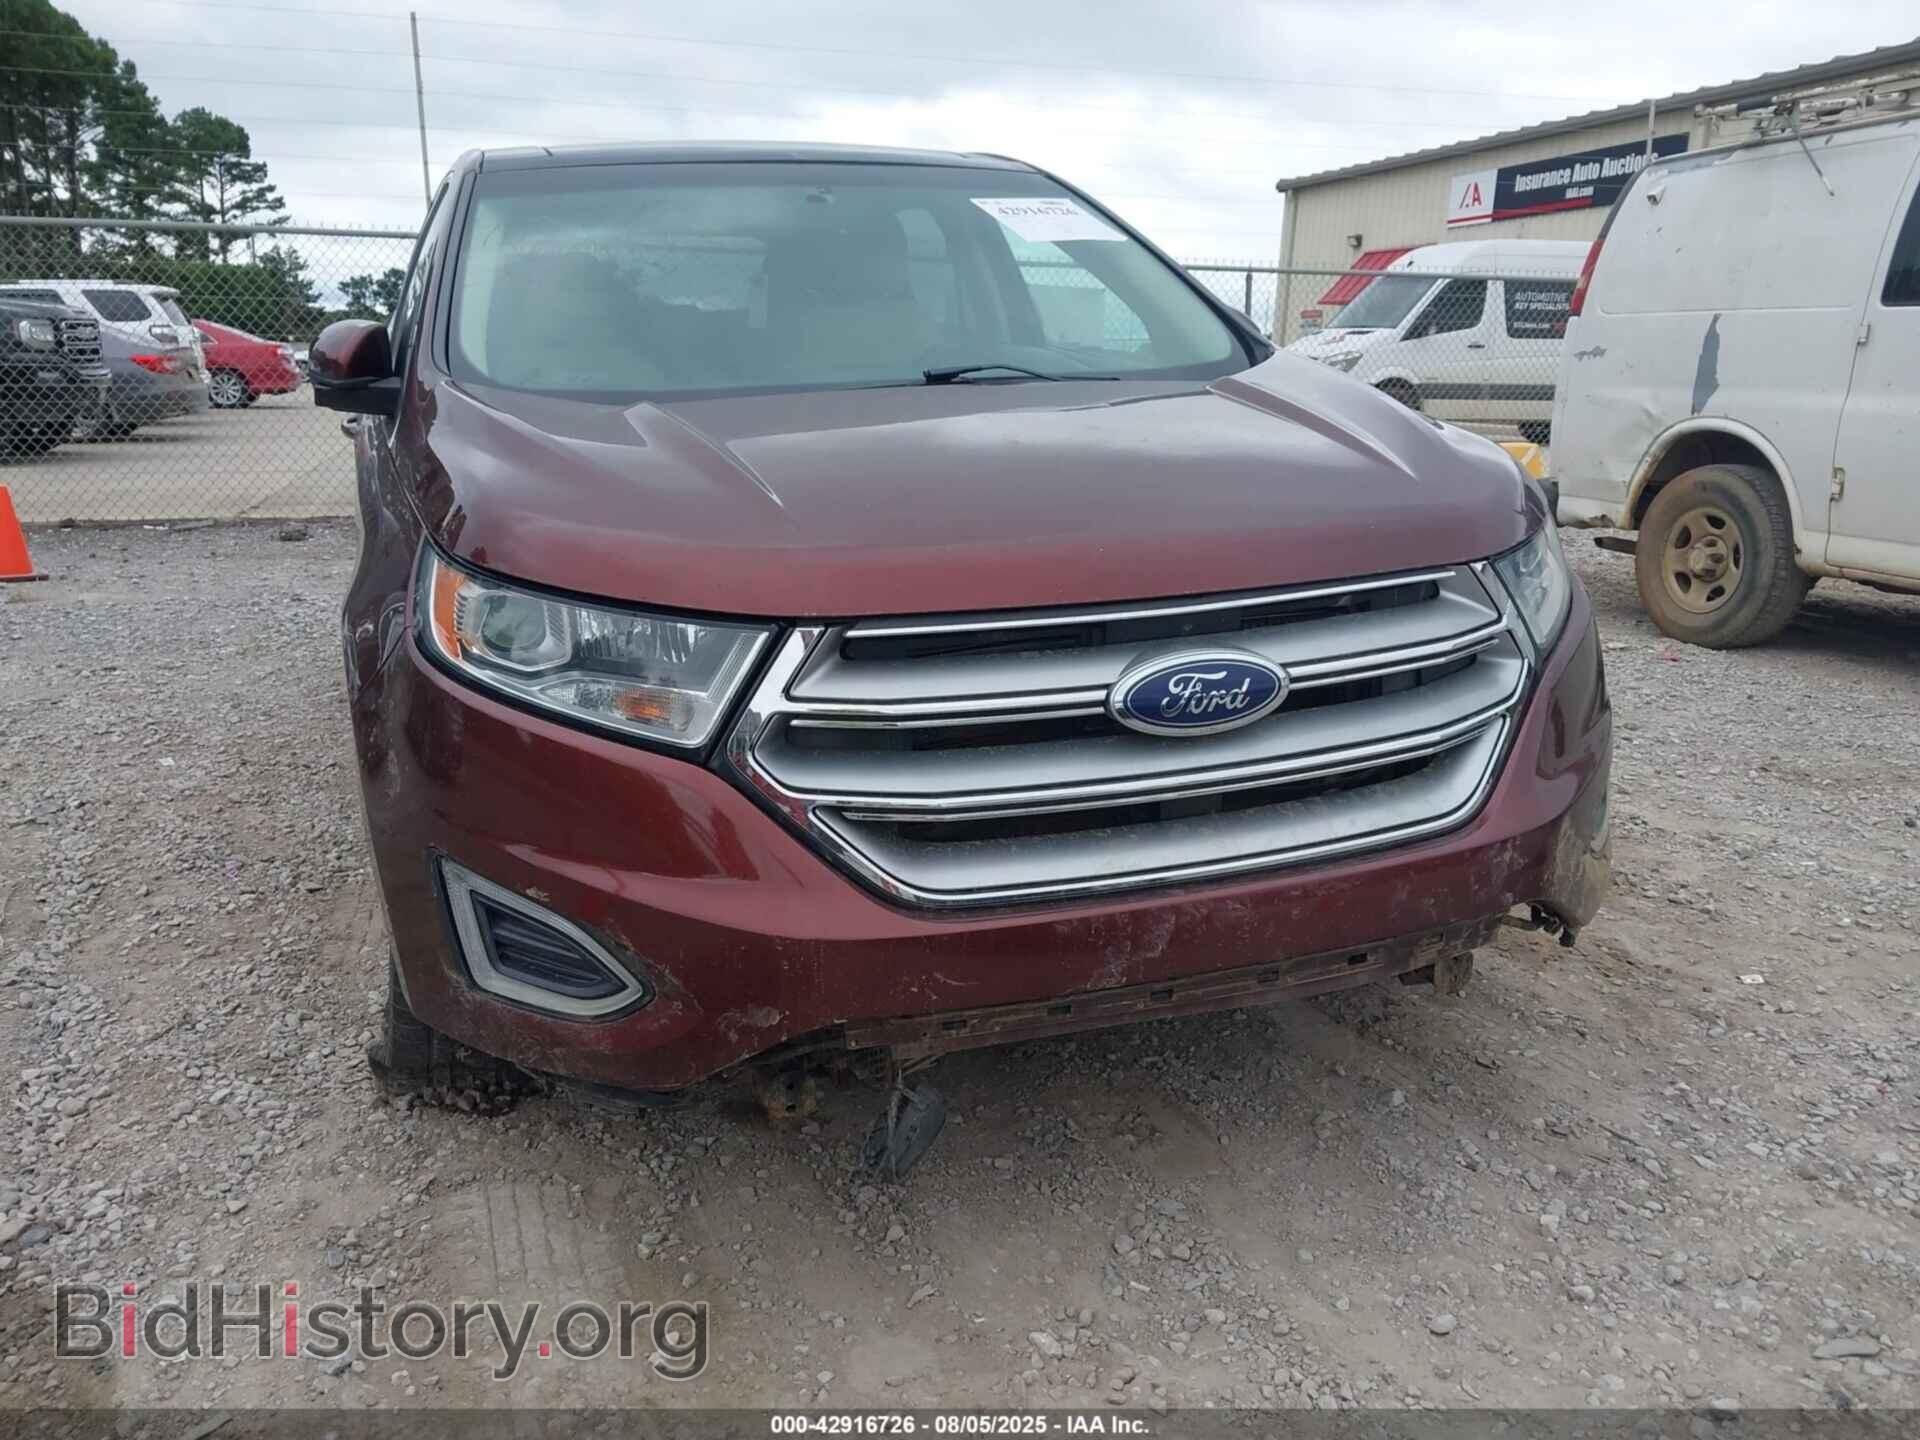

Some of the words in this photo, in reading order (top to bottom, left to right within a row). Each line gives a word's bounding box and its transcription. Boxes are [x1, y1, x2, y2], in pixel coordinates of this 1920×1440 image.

[1515, 168, 1571, 192] Insurance
[1572, 162, 1600, 183] Auto
[1514, 291, 1569, 302] AUTOMOTIVE
[1514, 302, 1529, 311] KEY
[1160, 671, 1250, 717] Ford
